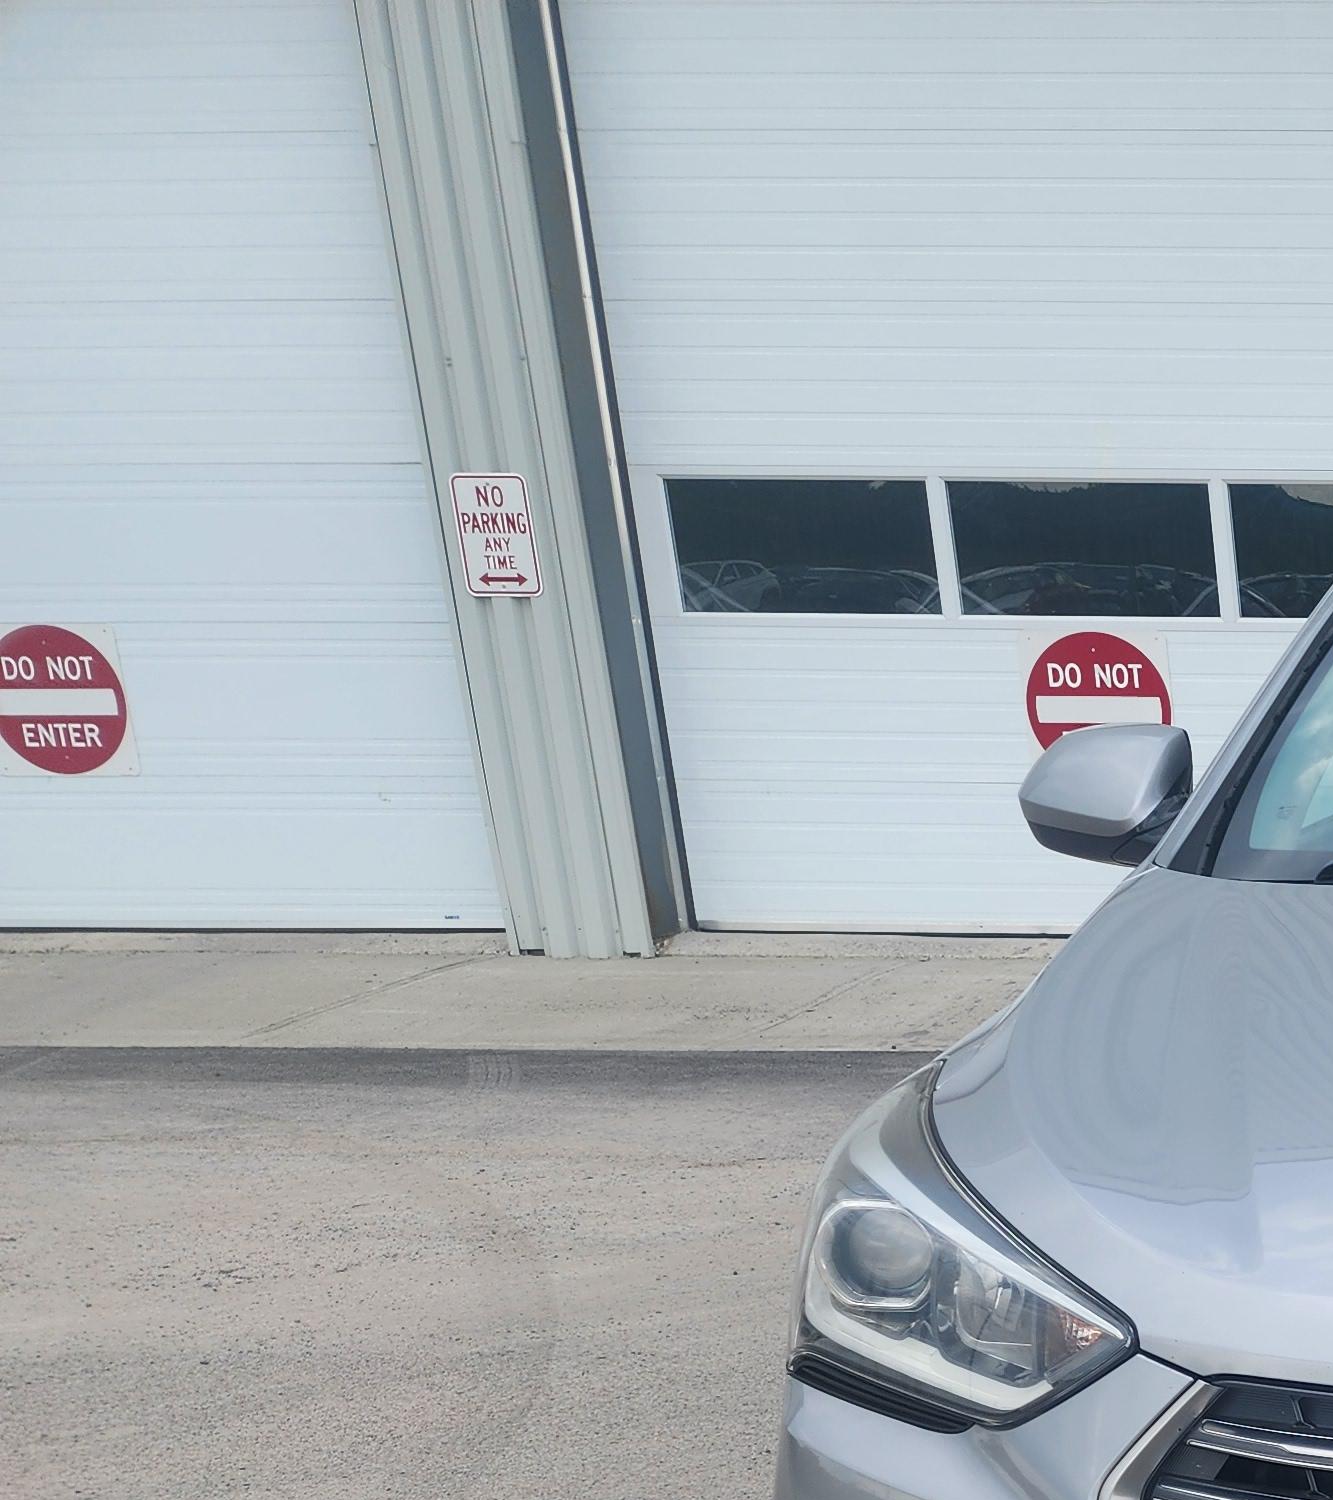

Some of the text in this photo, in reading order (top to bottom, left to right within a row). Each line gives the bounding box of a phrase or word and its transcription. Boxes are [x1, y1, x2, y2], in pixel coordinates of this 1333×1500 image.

[475, 485, 504, 508] NO
[461, 512, 527, 534] PARKING
[484, 537, 511, 552] ANY
[484, 555, 518, 570] TIME
[0, 655, 93, 681] DO NOT
[1046, 662, 1143, 689] DO NOT
[21, 723, 103, 748] ENTER
